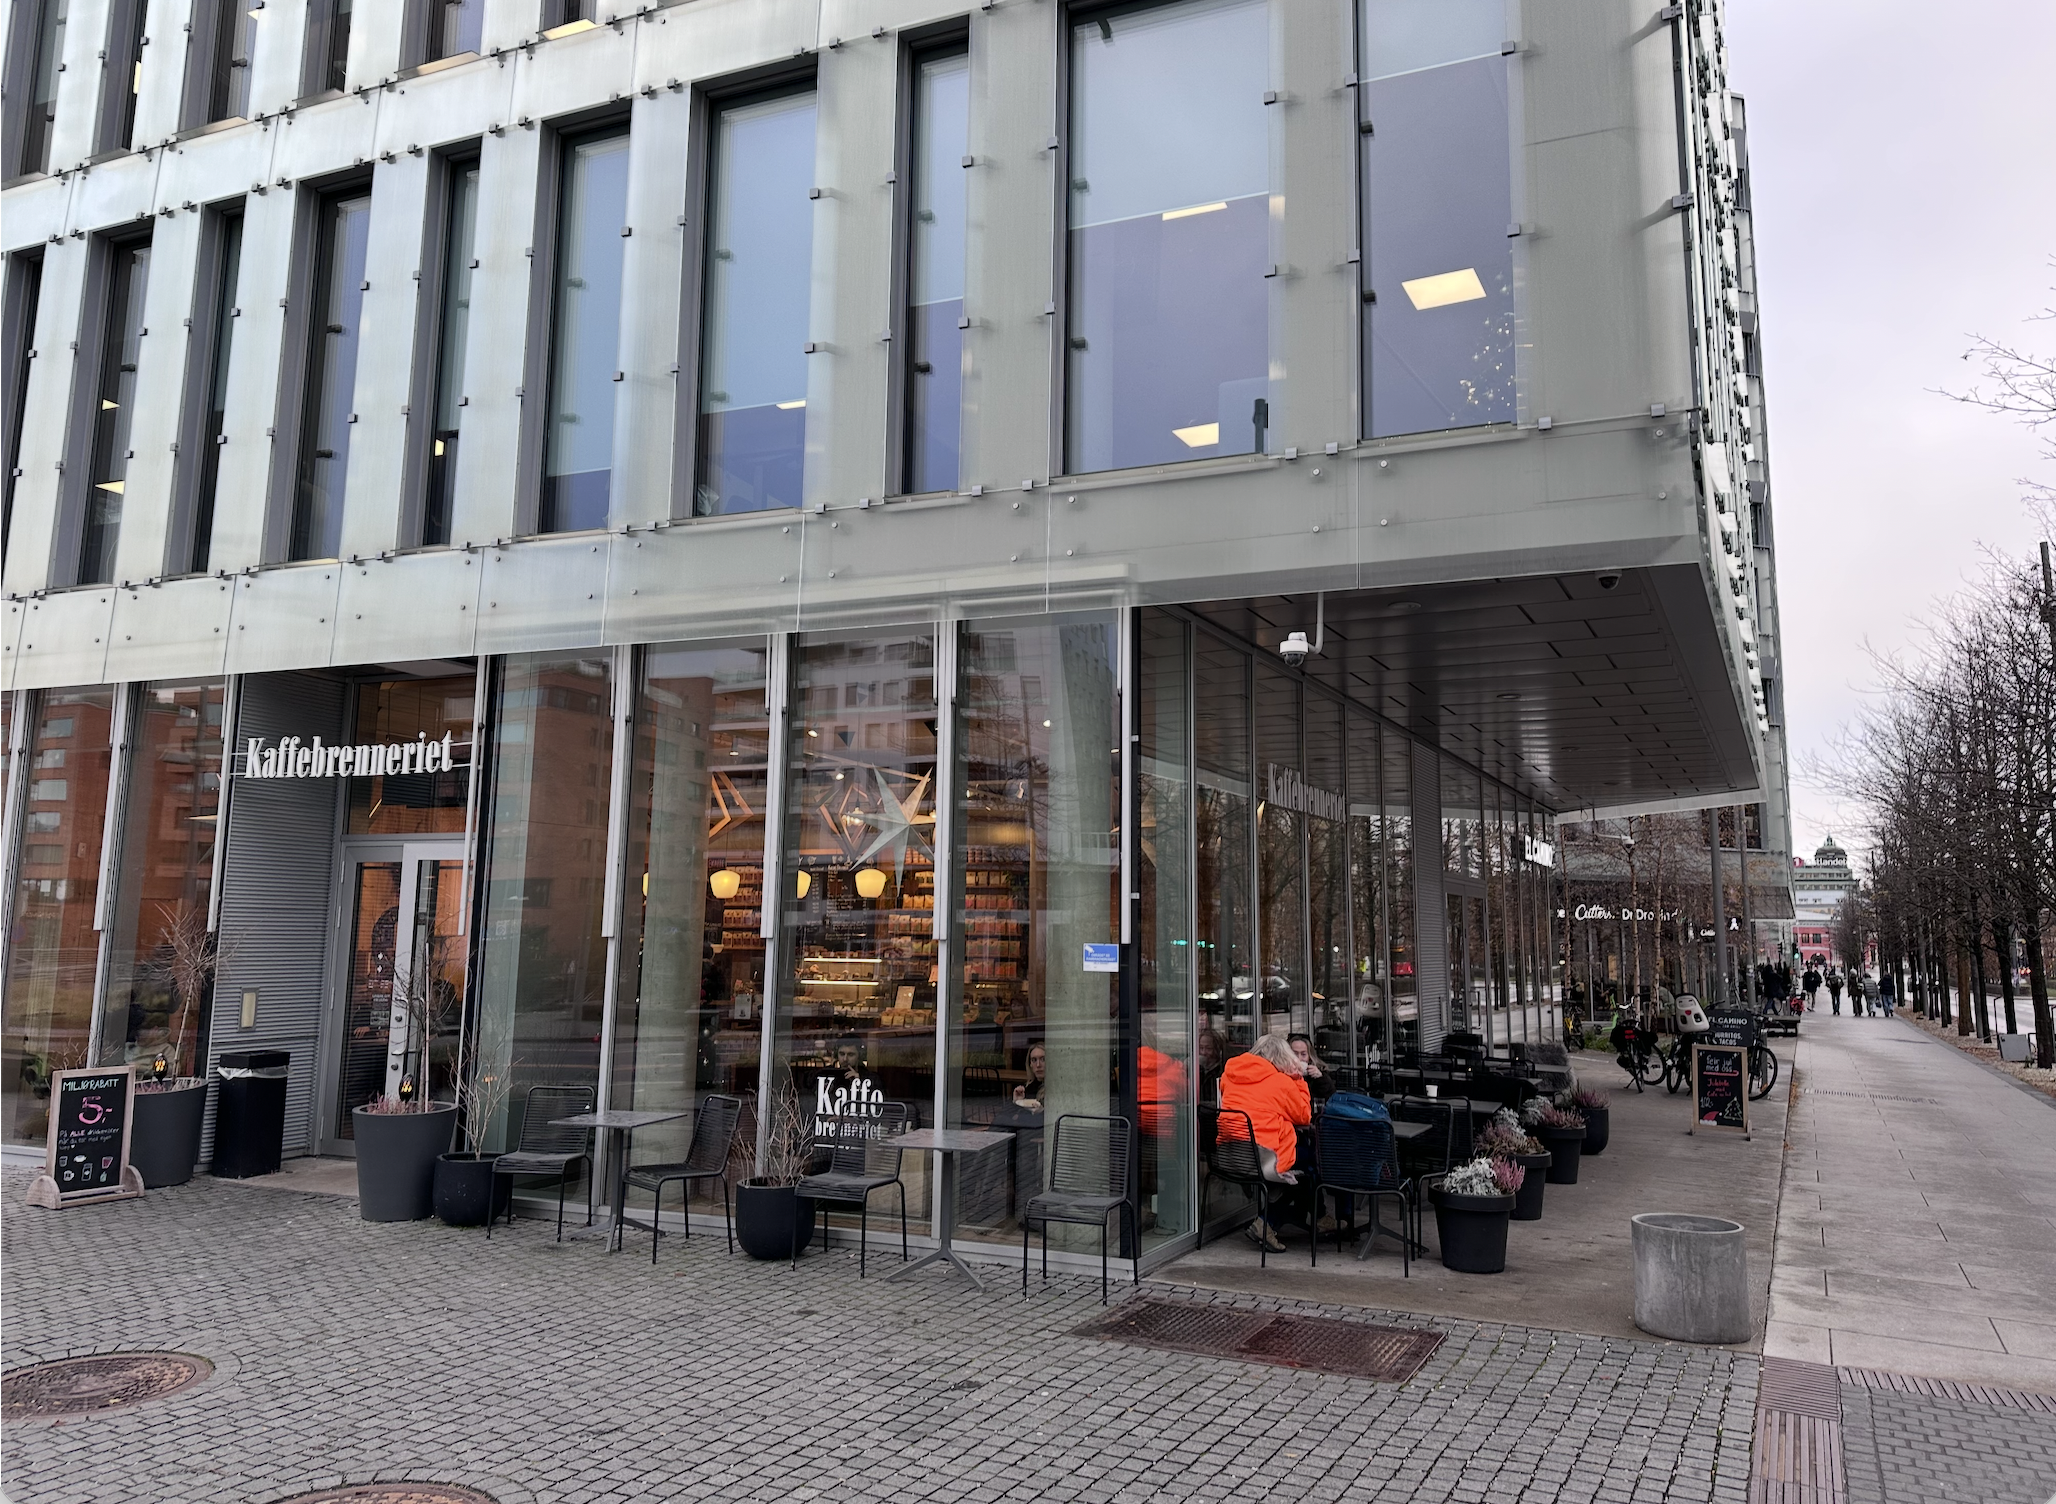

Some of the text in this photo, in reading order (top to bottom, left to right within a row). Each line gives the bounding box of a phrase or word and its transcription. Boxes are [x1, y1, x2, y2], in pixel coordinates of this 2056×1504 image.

[244, 730, 455, 778] Kaffebrenneriet
[1267, 762, 1346, 824] Kaffebrenneriet
[1718, 1017, 1748, 1025] CAMINO
[1719, 1038, 1737, 1046] TACOS
[62, 1078, 119, 1091] MILJØRABATT
[816, 1076, 883, 1117] Kaffe
[69, 1129, 85, 1137] ALLE
